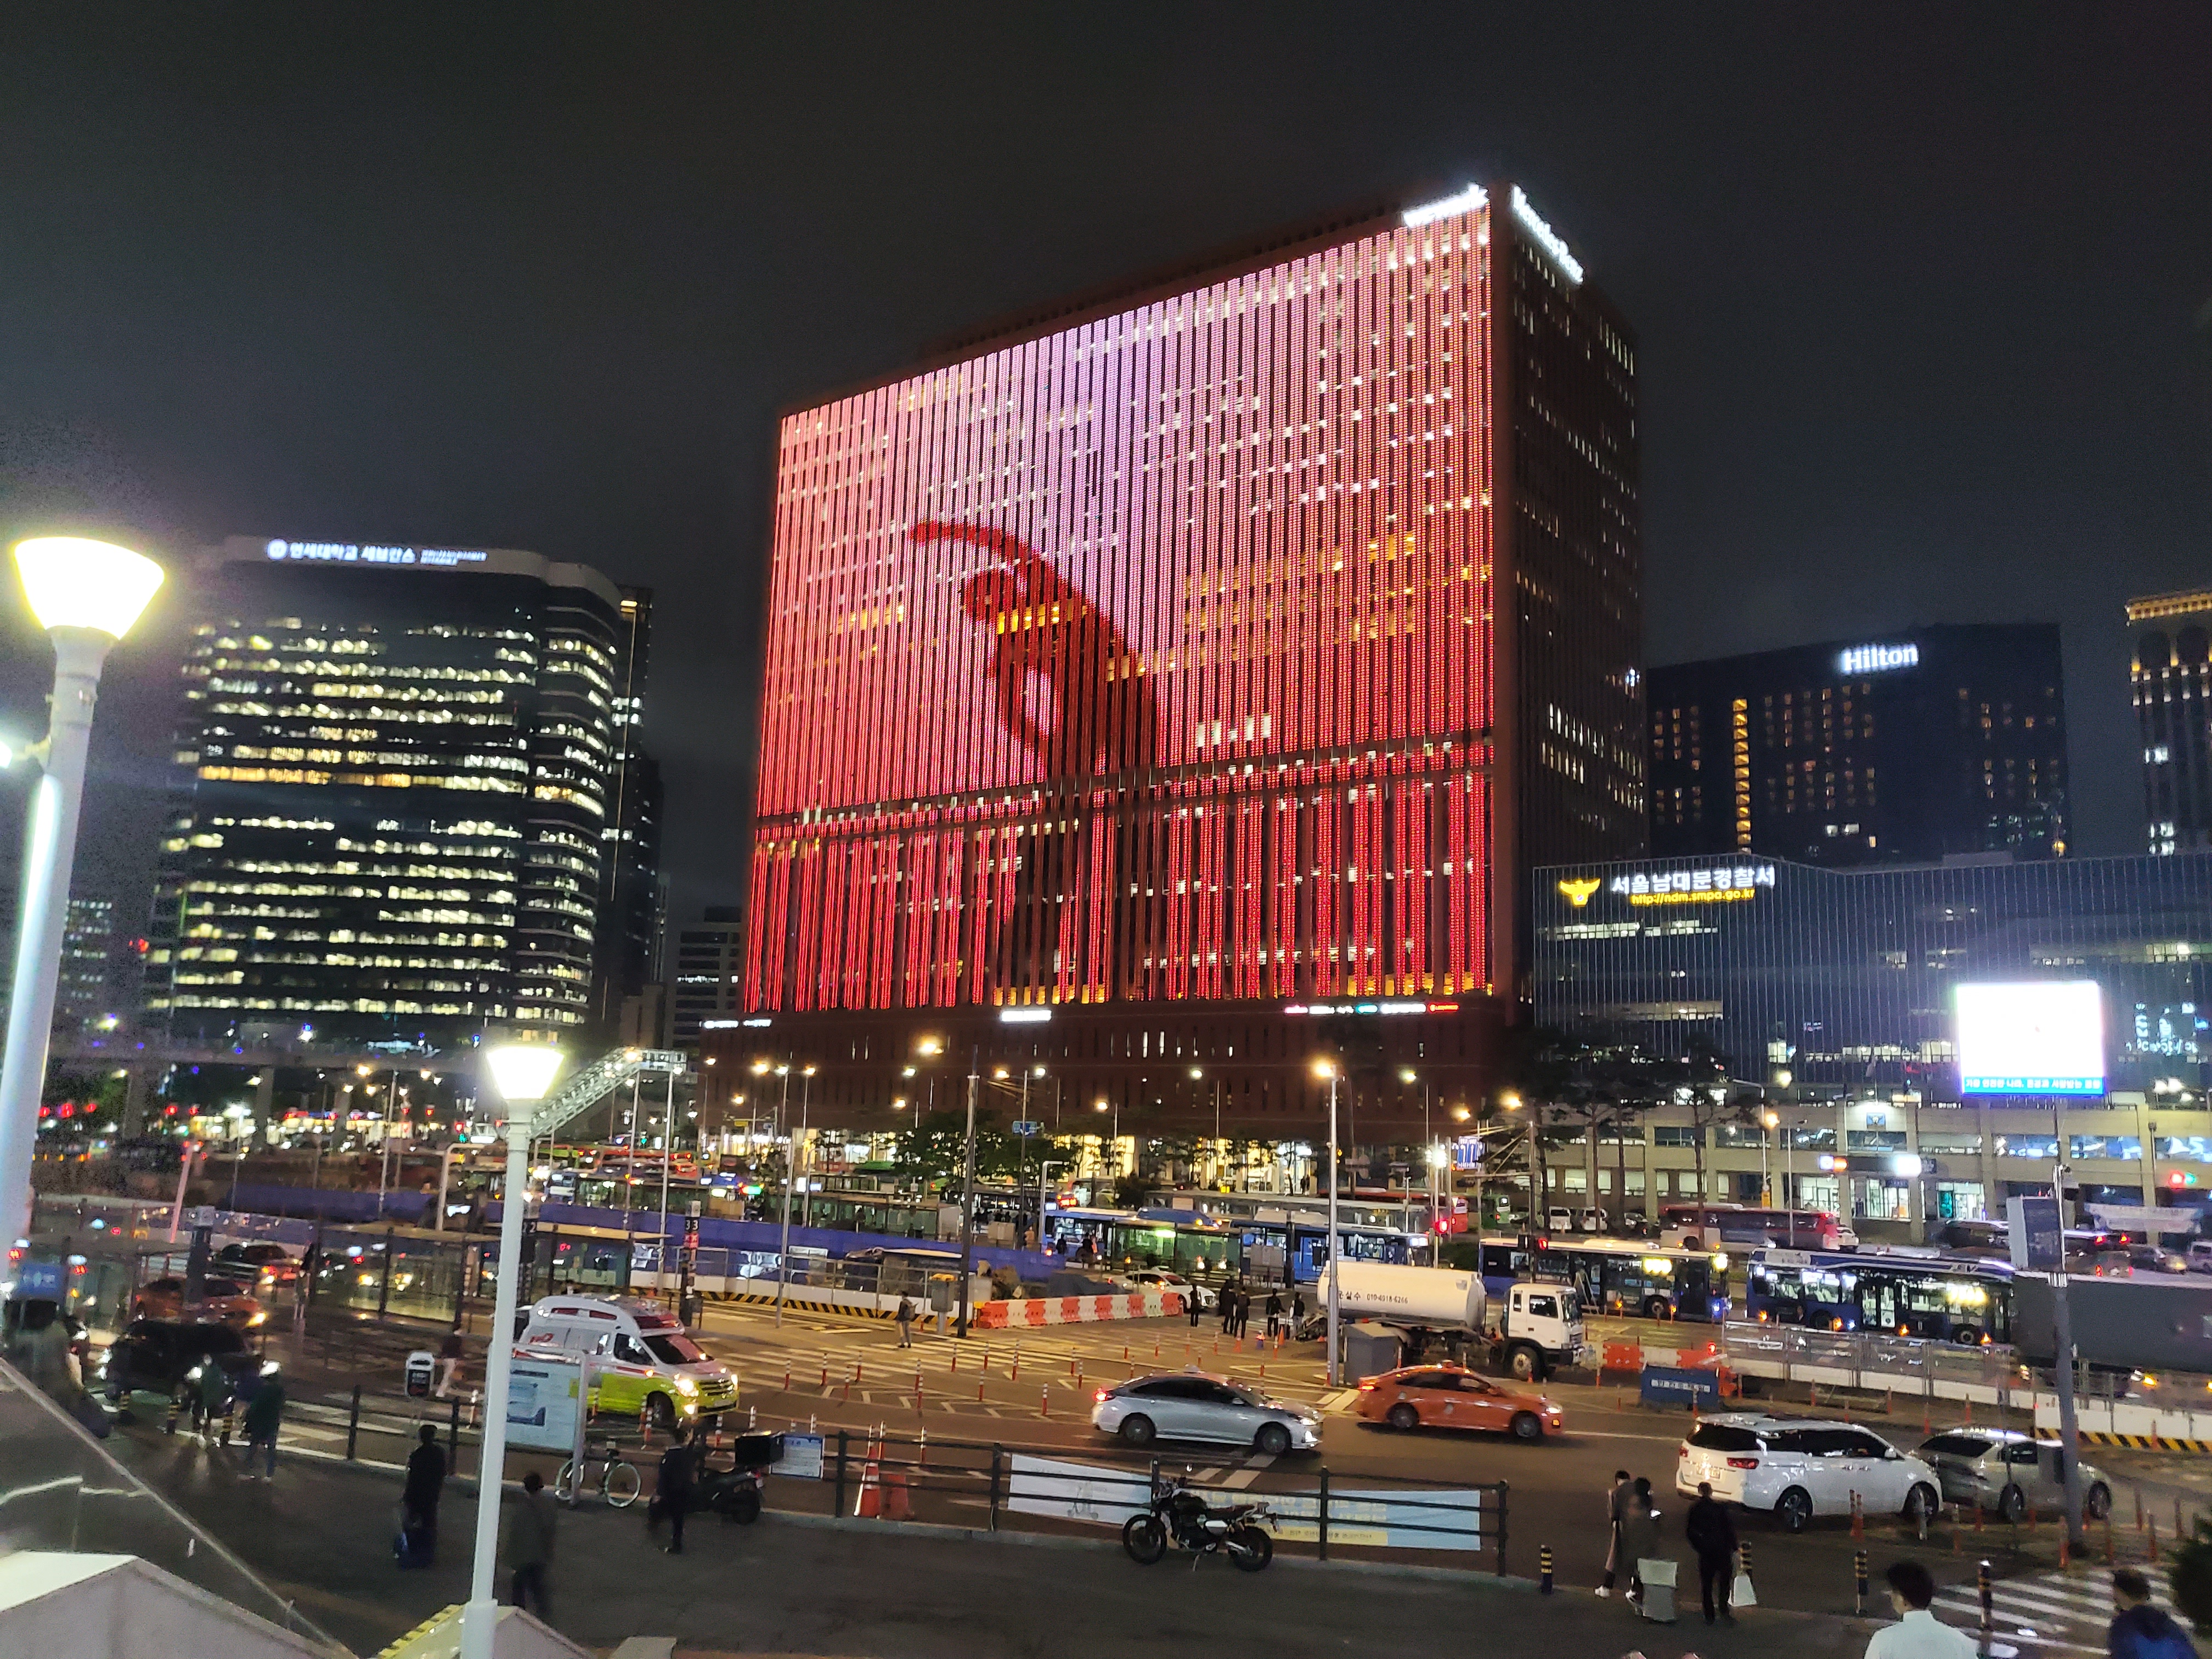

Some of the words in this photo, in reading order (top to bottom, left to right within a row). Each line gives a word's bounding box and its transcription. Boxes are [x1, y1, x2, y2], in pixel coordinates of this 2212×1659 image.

[1842, 647, 1919, 672] Hilton
[1611, 865, 1775, 894] 서울남대문경찰서
[1630, 888, 1755, 905] http://ndm.smpa.go.kr
